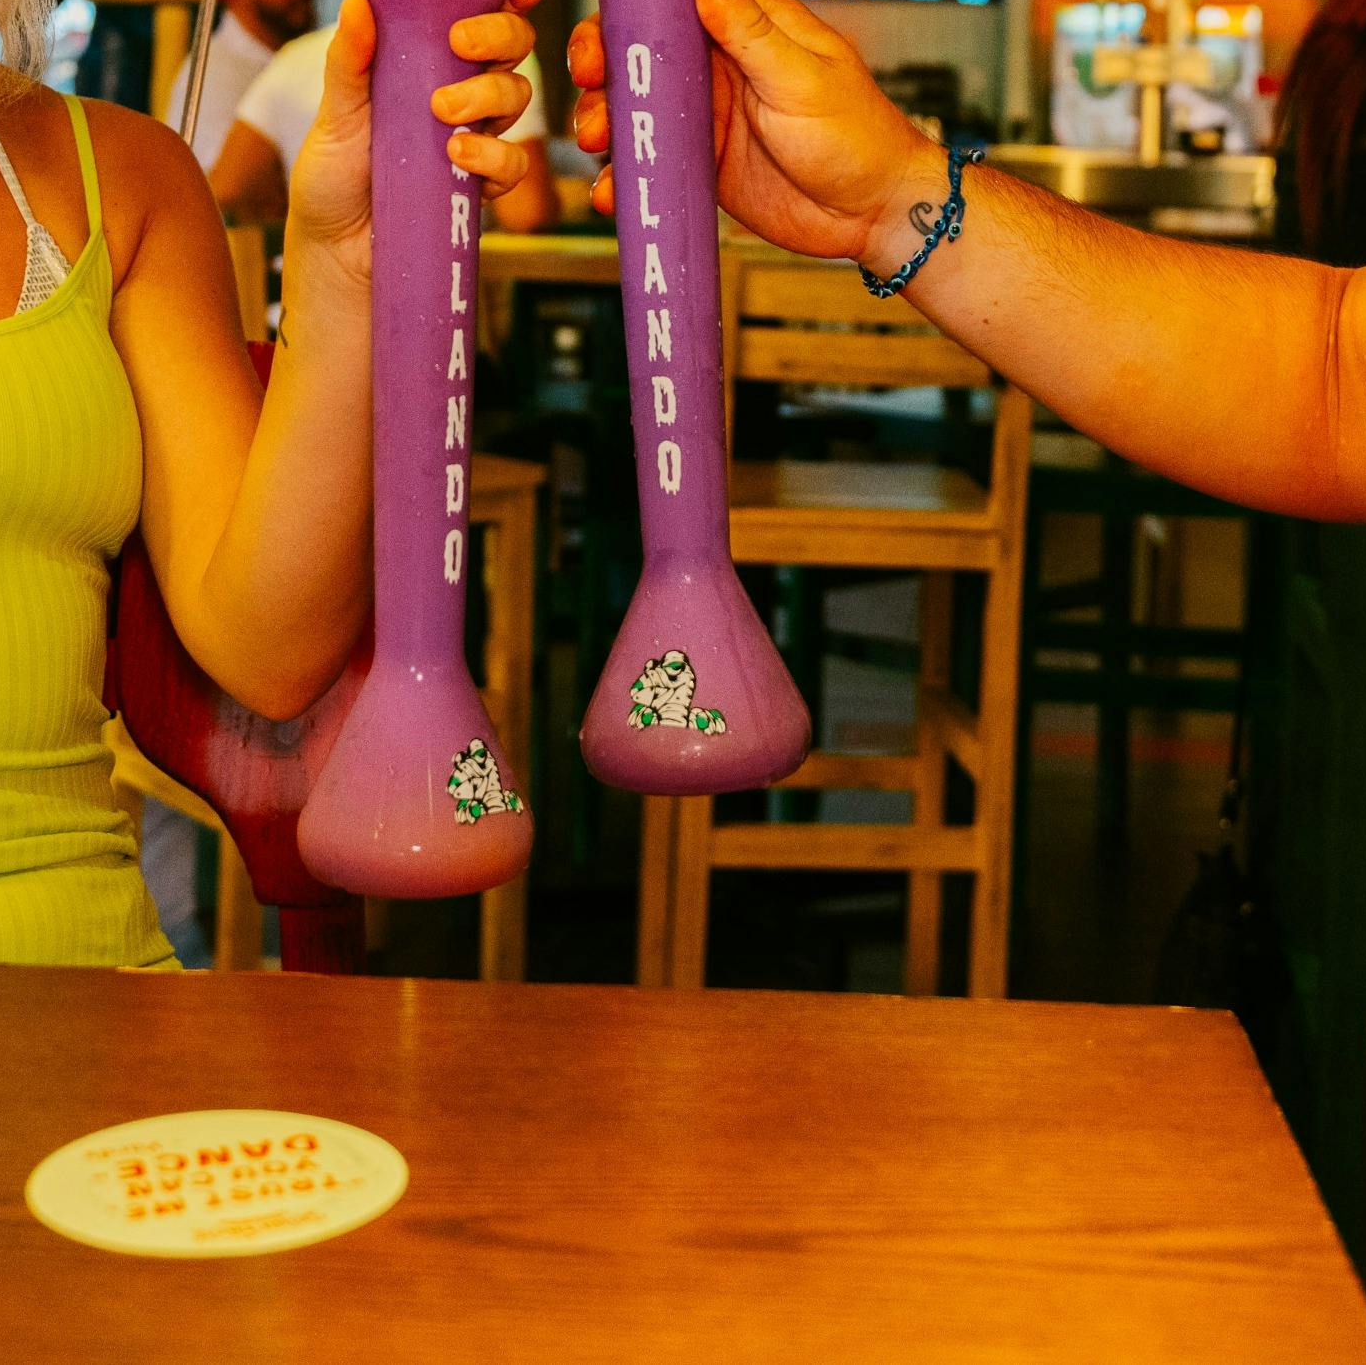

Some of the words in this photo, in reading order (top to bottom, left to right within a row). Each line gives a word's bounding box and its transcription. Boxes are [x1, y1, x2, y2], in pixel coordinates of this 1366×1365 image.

[626, 43, 683, 495] ORLANDO
[117, 1133, 319, 1178] DANCE
[232, 1156, 319, 1180] YOU
[206, 1174, 339, 1208] TRUST
[126, 1197, 186, 1221] ME
